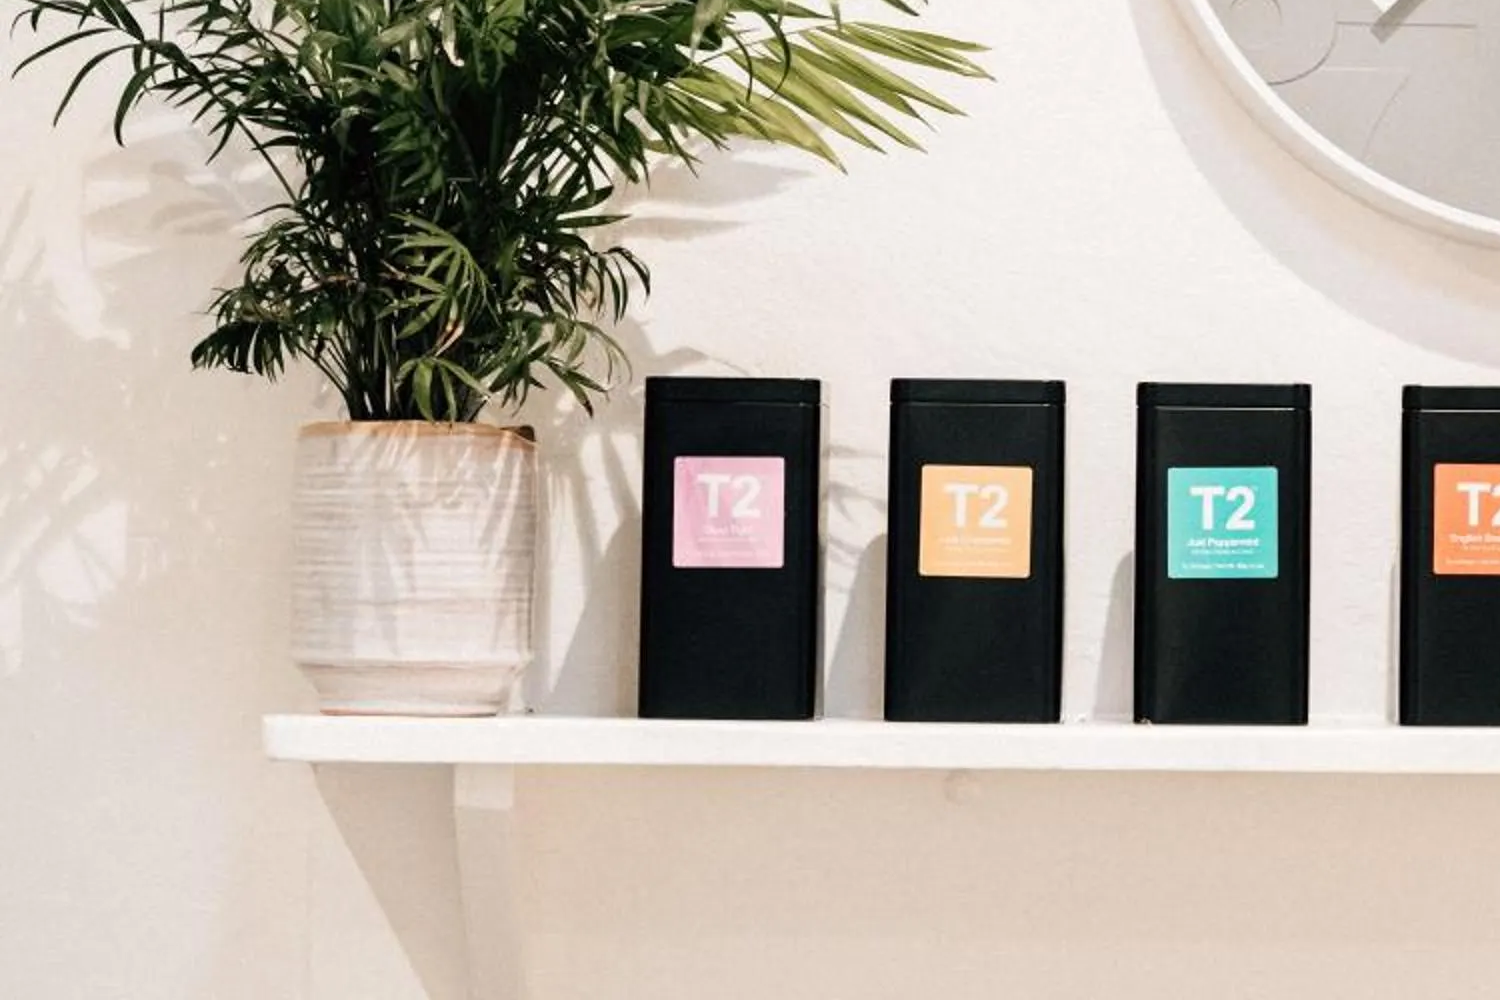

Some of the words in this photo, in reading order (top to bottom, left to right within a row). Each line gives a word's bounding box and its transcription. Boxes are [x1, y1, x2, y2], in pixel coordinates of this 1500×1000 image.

[697, 473, 762, 518] T2
[944, 483, 1009, 529] T2
[1189, 485, 1256, 531] T2
